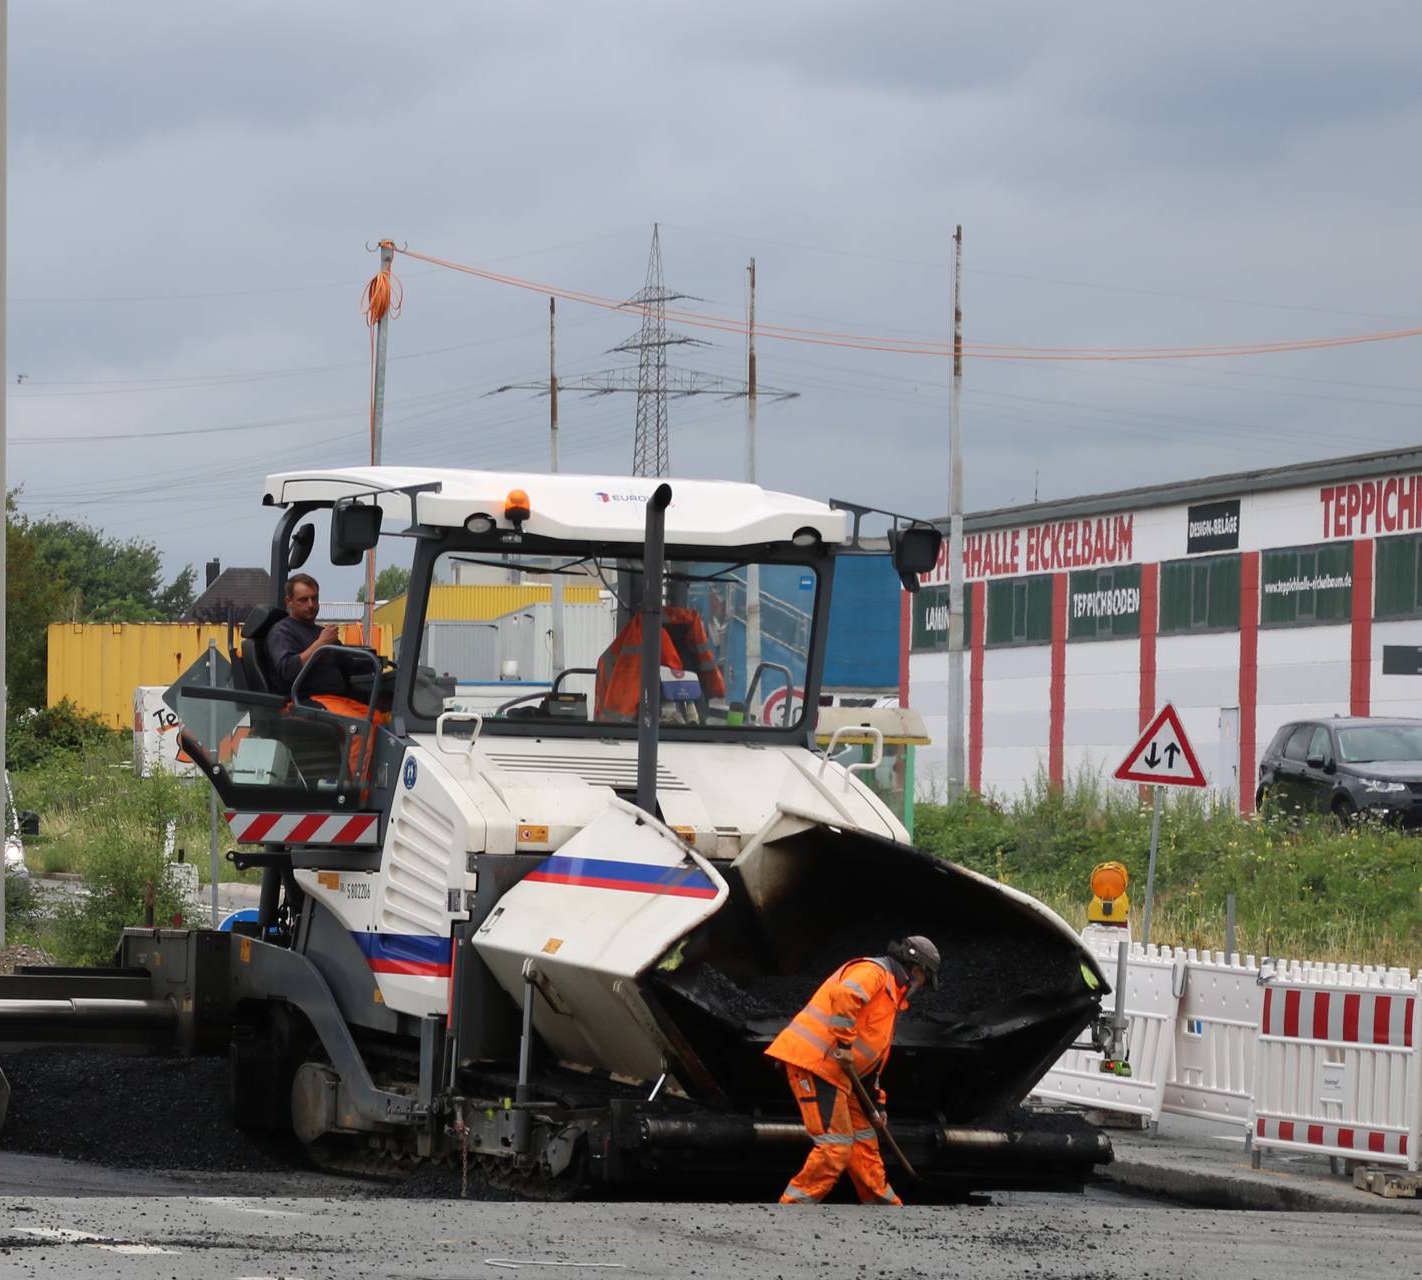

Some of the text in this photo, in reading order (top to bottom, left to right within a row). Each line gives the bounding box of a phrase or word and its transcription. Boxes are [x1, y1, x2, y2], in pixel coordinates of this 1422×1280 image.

[919, 512, 1134, 583] PIHHALLE EICKELBAUM
[1073, 588, 1140, 618] TEPPICHBODEN
[925, 604, 949, 631] LAMIN
[153, 708, 179, 730] Te
